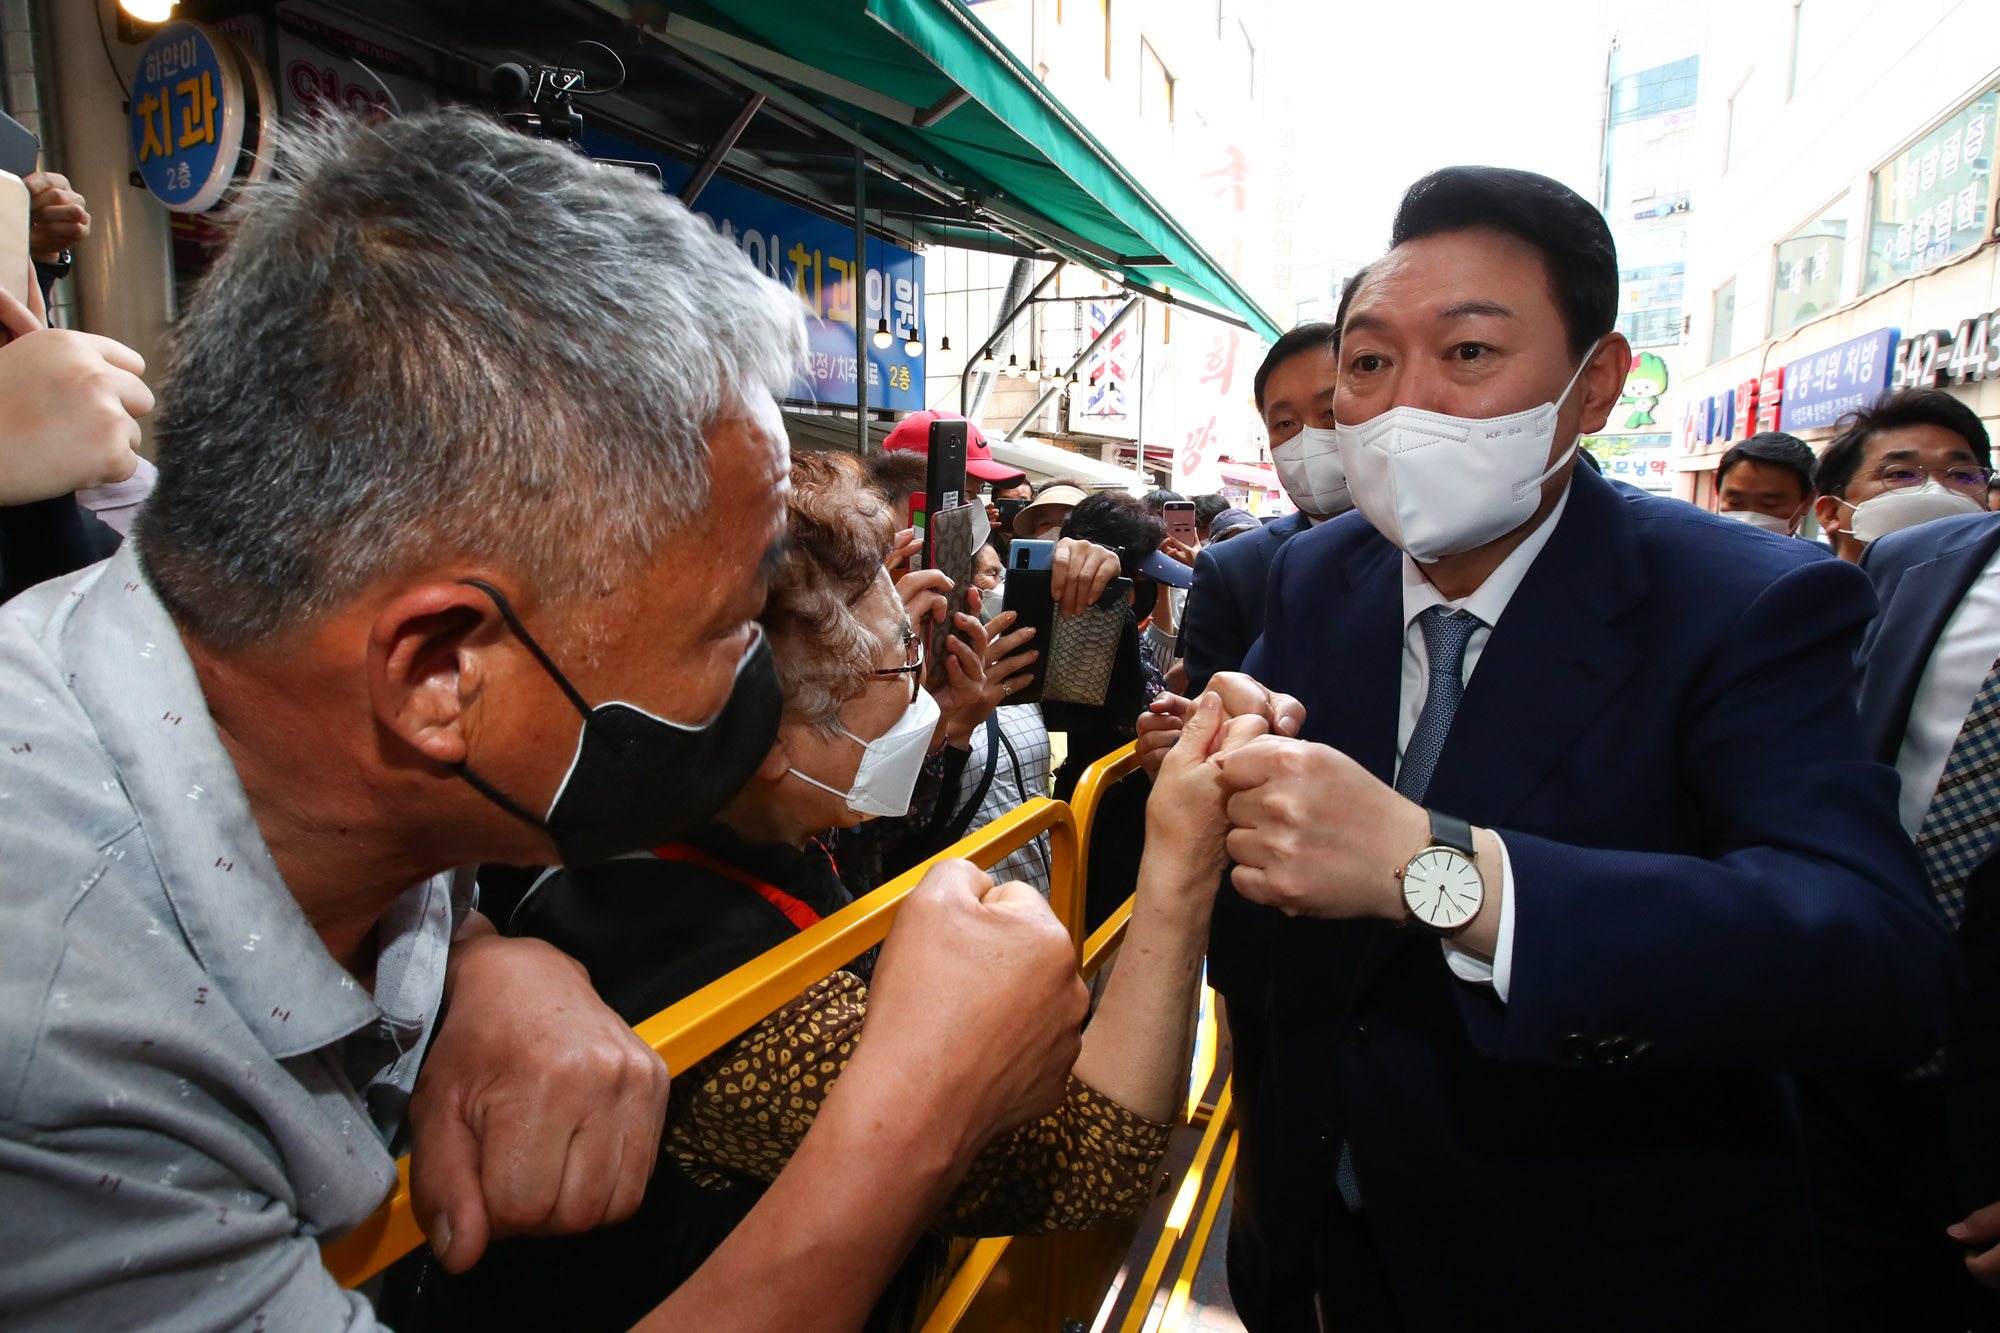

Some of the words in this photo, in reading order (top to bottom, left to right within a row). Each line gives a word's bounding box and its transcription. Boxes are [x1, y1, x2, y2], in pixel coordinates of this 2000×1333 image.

[146, 35, 196, 83] 하얀이
[137, 70, 217, 162] 치과
[166, 161, 191, 190] 2층
[1904, 112, 1986, 199] 예방접종
[1896, 181, 1978, 262] 건강검진
[889, 365, 911, 391] 2층
[1844, 337, 1879, 385] 처방
[1485, 431, 1502, 440] KF
[1508, 427, 1522, 436] 94
[1599, 460, 1675, 477] 모닝약
